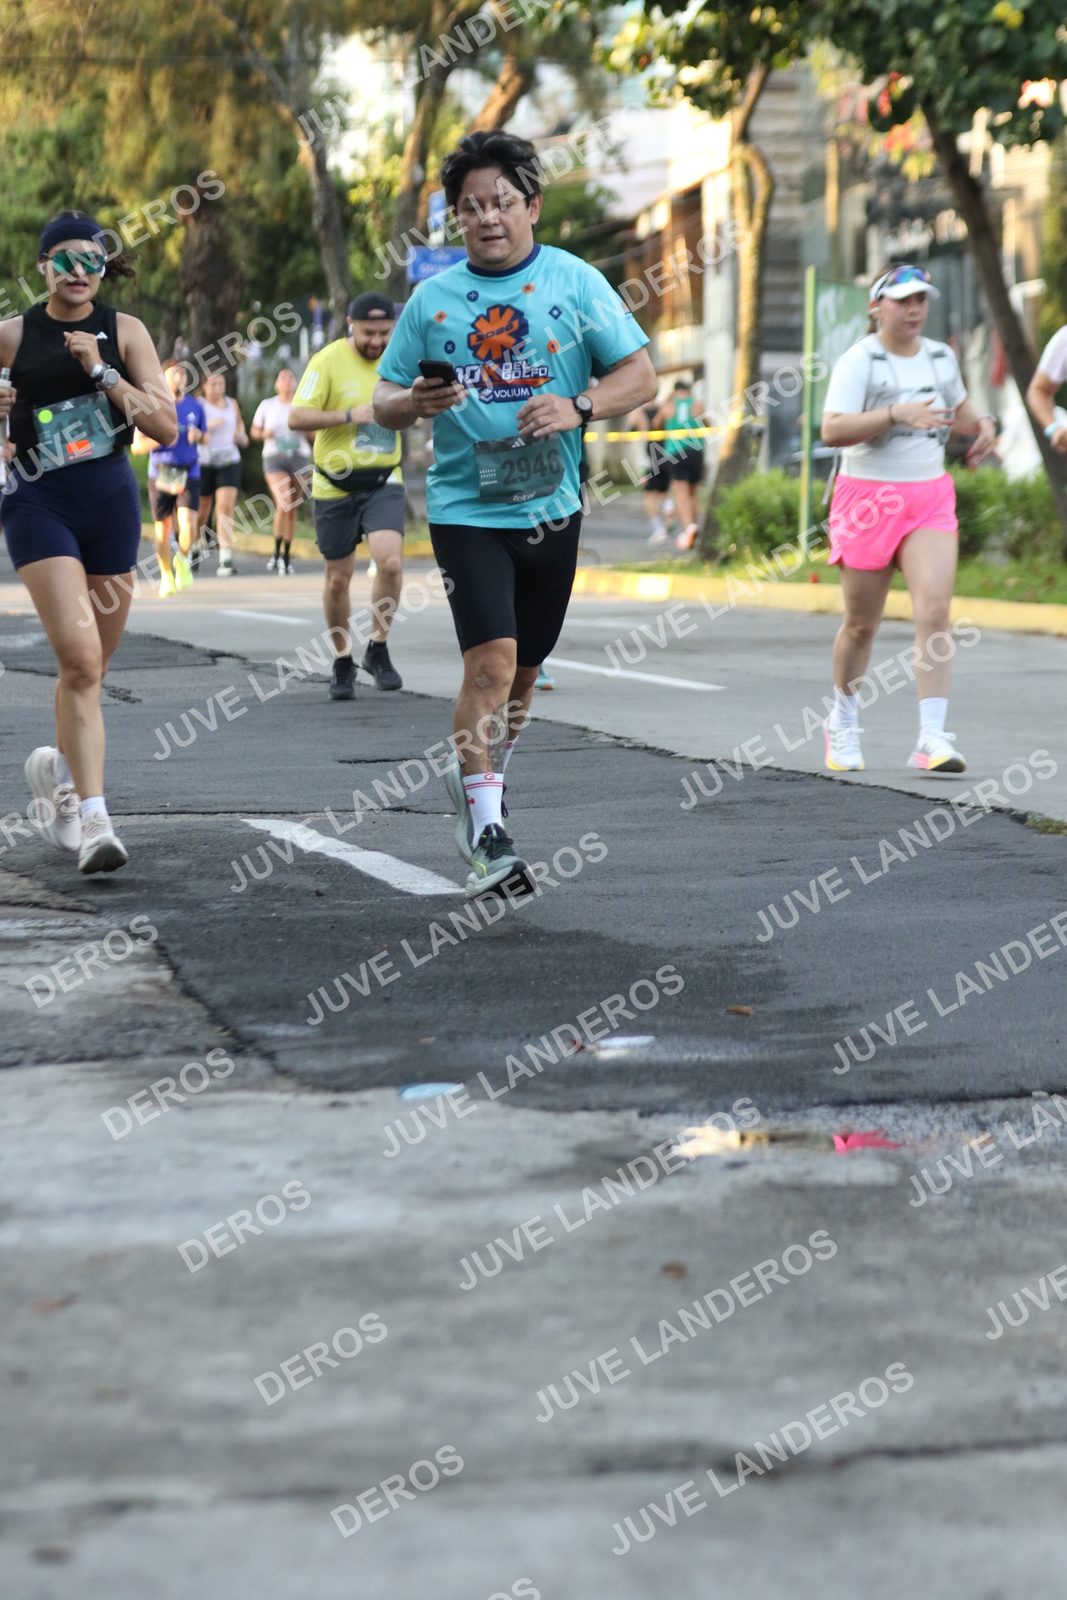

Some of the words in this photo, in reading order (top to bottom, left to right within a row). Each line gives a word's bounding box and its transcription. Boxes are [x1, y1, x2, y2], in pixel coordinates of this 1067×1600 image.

[503, 361, 531, 371] DEL
[502, 366, 548, 380] GOLFO
[493, 387, 530, 398] VOLIUM
[501, 448, 563, 486] 2946
